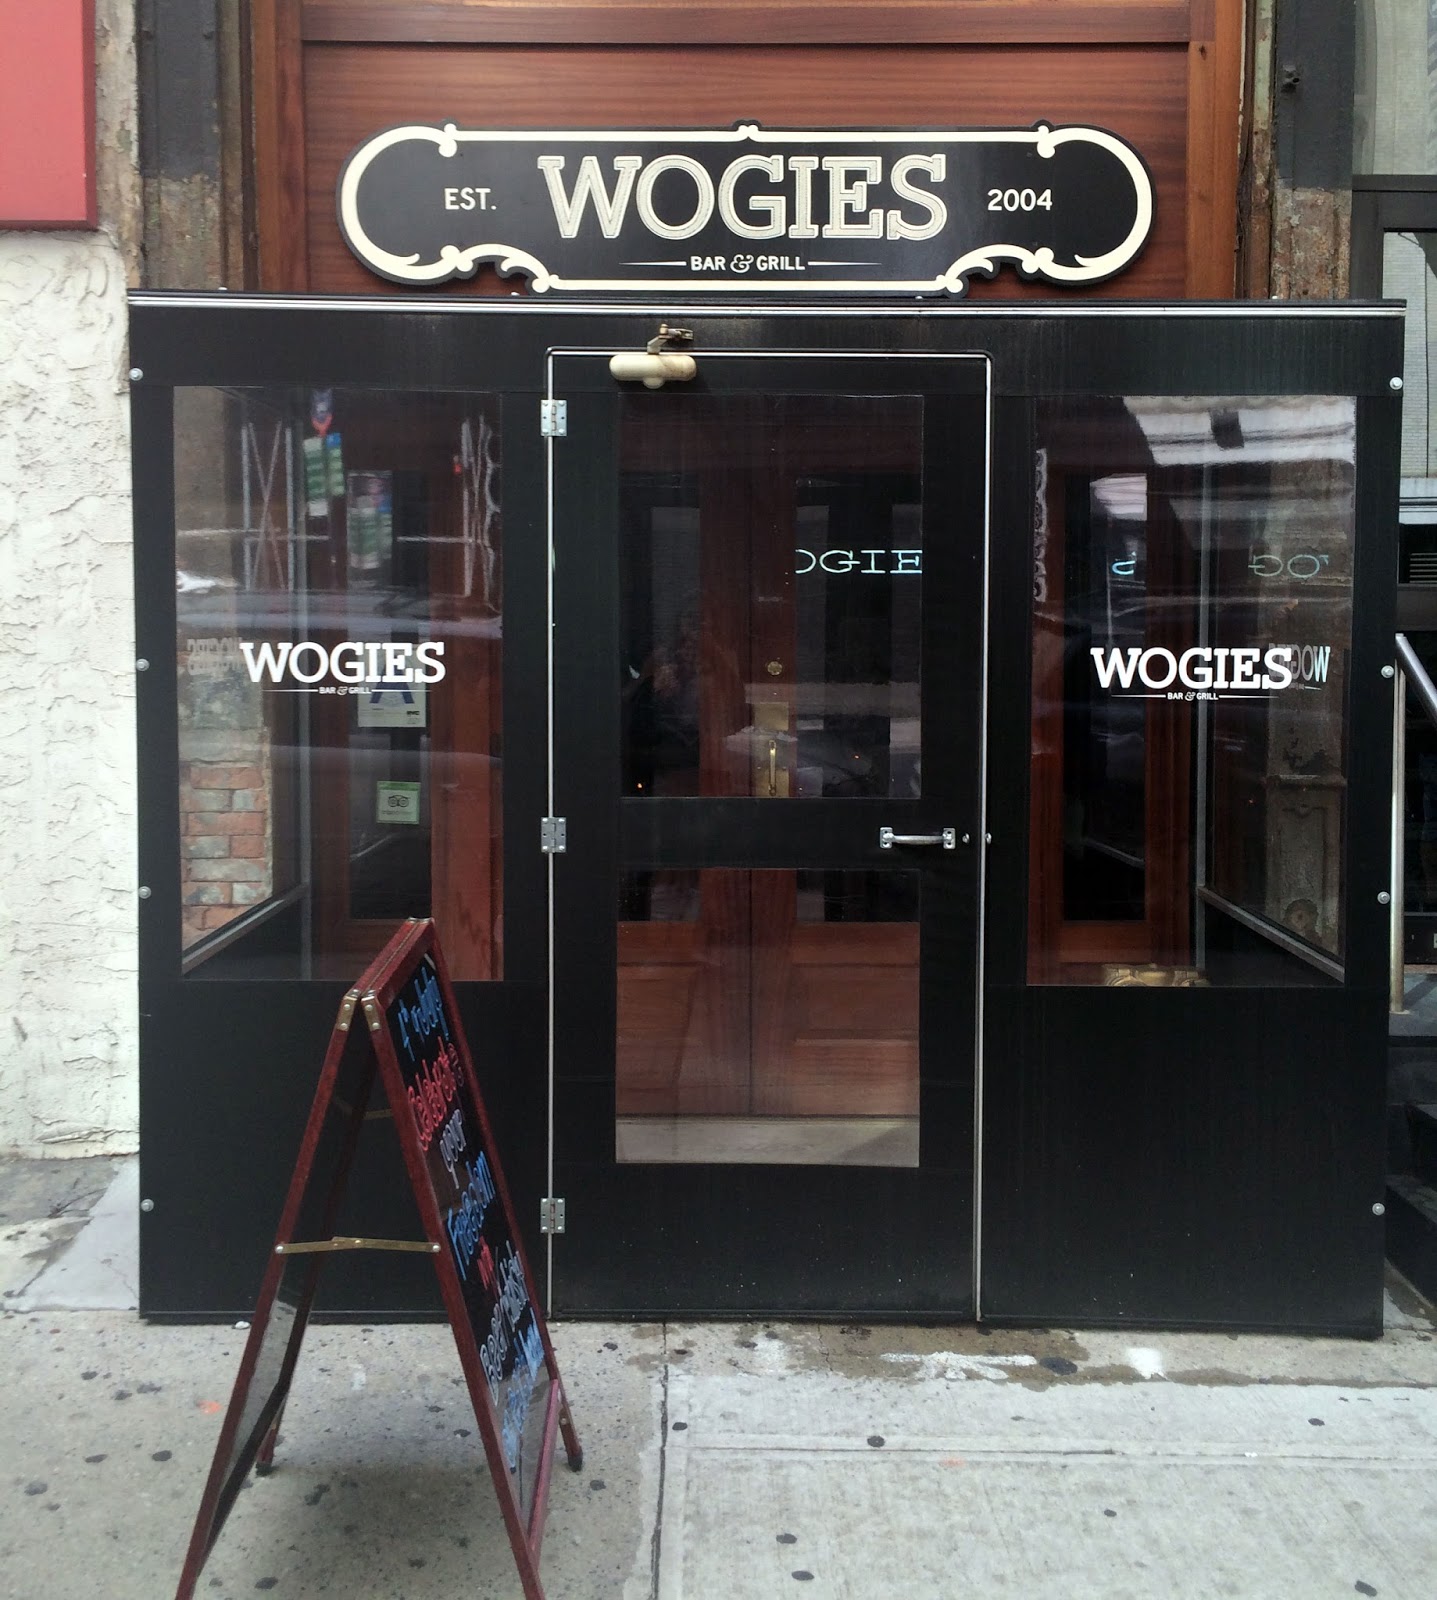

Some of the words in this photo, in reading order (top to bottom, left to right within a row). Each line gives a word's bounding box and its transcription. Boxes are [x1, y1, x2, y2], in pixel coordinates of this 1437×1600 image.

[444, 187, 497, 211] EST.
[537, 154, 948, 240] WOGIES
[987, 189, 1053, 211] 2004
[690, 255, 726, 271] BAR
[730, 253, 755, 273] &
[756, 255, 806, 271] GRILL
[239, 641, 447, 684] WOGIES
[1089, 647, 1293, 690] WOGIES
[318, 686, 337, 694] BAR
[337, 685, 348, 696] &
[348, 686, 372, 695] GRILL
[1167, 692, 1184, 700] BAR
[1184, 691, 1197, 702] &
[1196, 692, 1219, 700] GRILL
